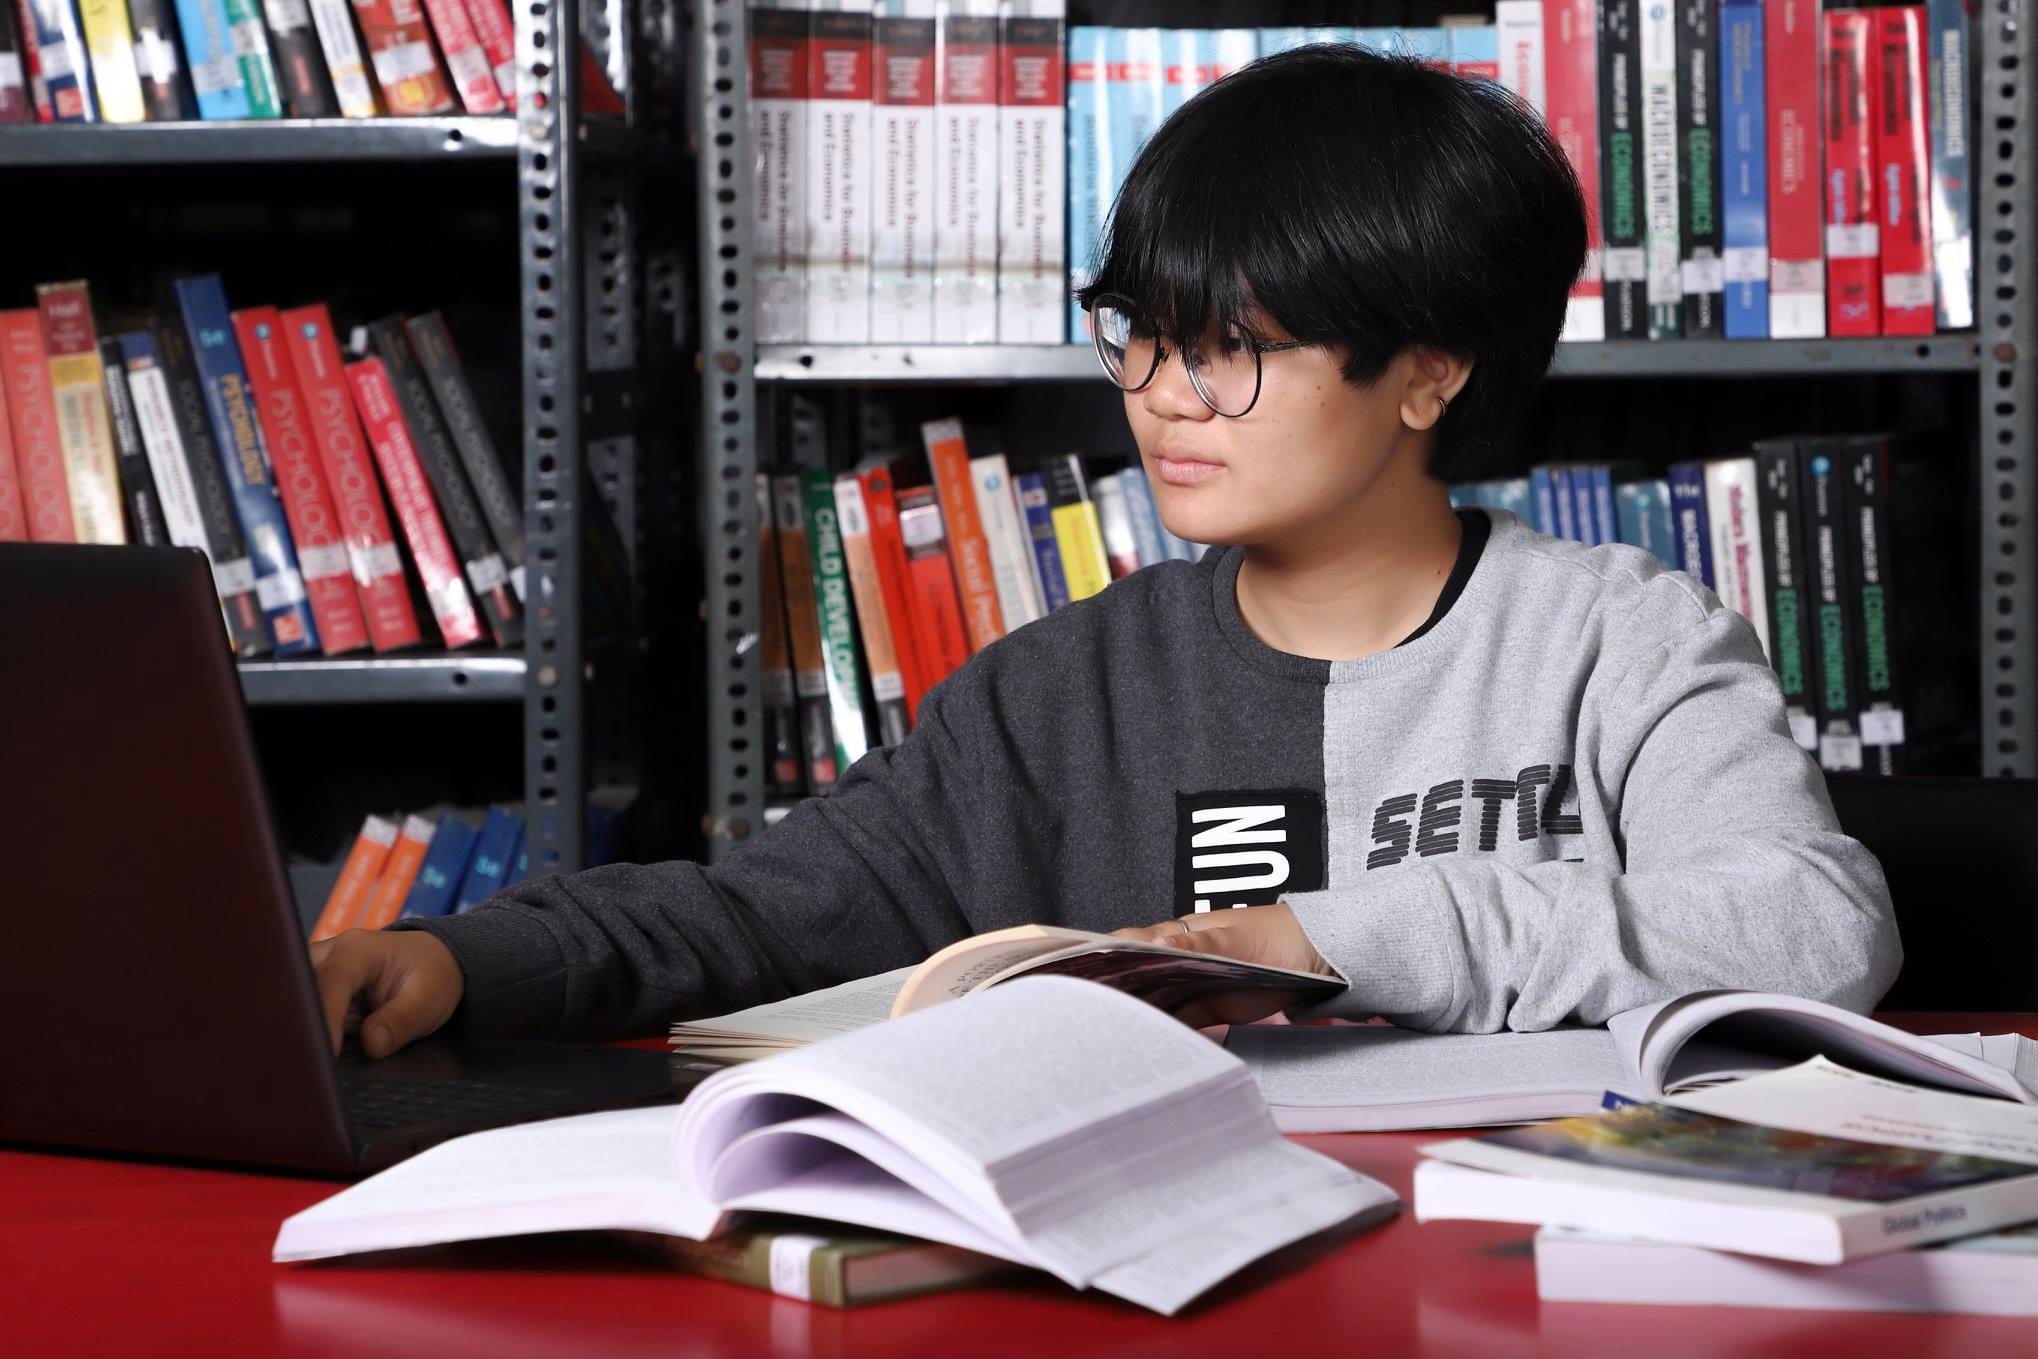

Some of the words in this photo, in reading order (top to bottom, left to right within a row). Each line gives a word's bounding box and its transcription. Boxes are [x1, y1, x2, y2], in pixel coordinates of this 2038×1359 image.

[824, 112, 833, 138] and
[888, 119, 897, 145] and
[950, 117, 960, 143] and
[1015, 119, 1025, 145] and
[1943, 28, 1963, 158] MACROECONOMICS
[843, 184, 854, 199] for
[907, 192, 918, 206] for
[968, 189, 979, 204] for
[1034, 192, 1045, 206] for
[1611, 132, 1633, 238] ECONOMICS
[1651, 85, 1673, 231] MACROECONOMICS
[1690, 128, 1712, 235] ECONOMICS
[269, 388, 331, 546] PSYCHOLO
[318, 387, 383, 546] PSYCHOLOG
[814, 508, 843, 575] CHILD
[819, 574, 861, 698] DEVELOP
[1775, 589, 1803, 695] ECONOMICS
[1819, 604, 1847, 711] ECONOMICS
[1862, 585, 1890, 691] ECONOMICS
[1191, 805, 1290, 913] UN
[1922, 1204, 1967, 1227] Politics
